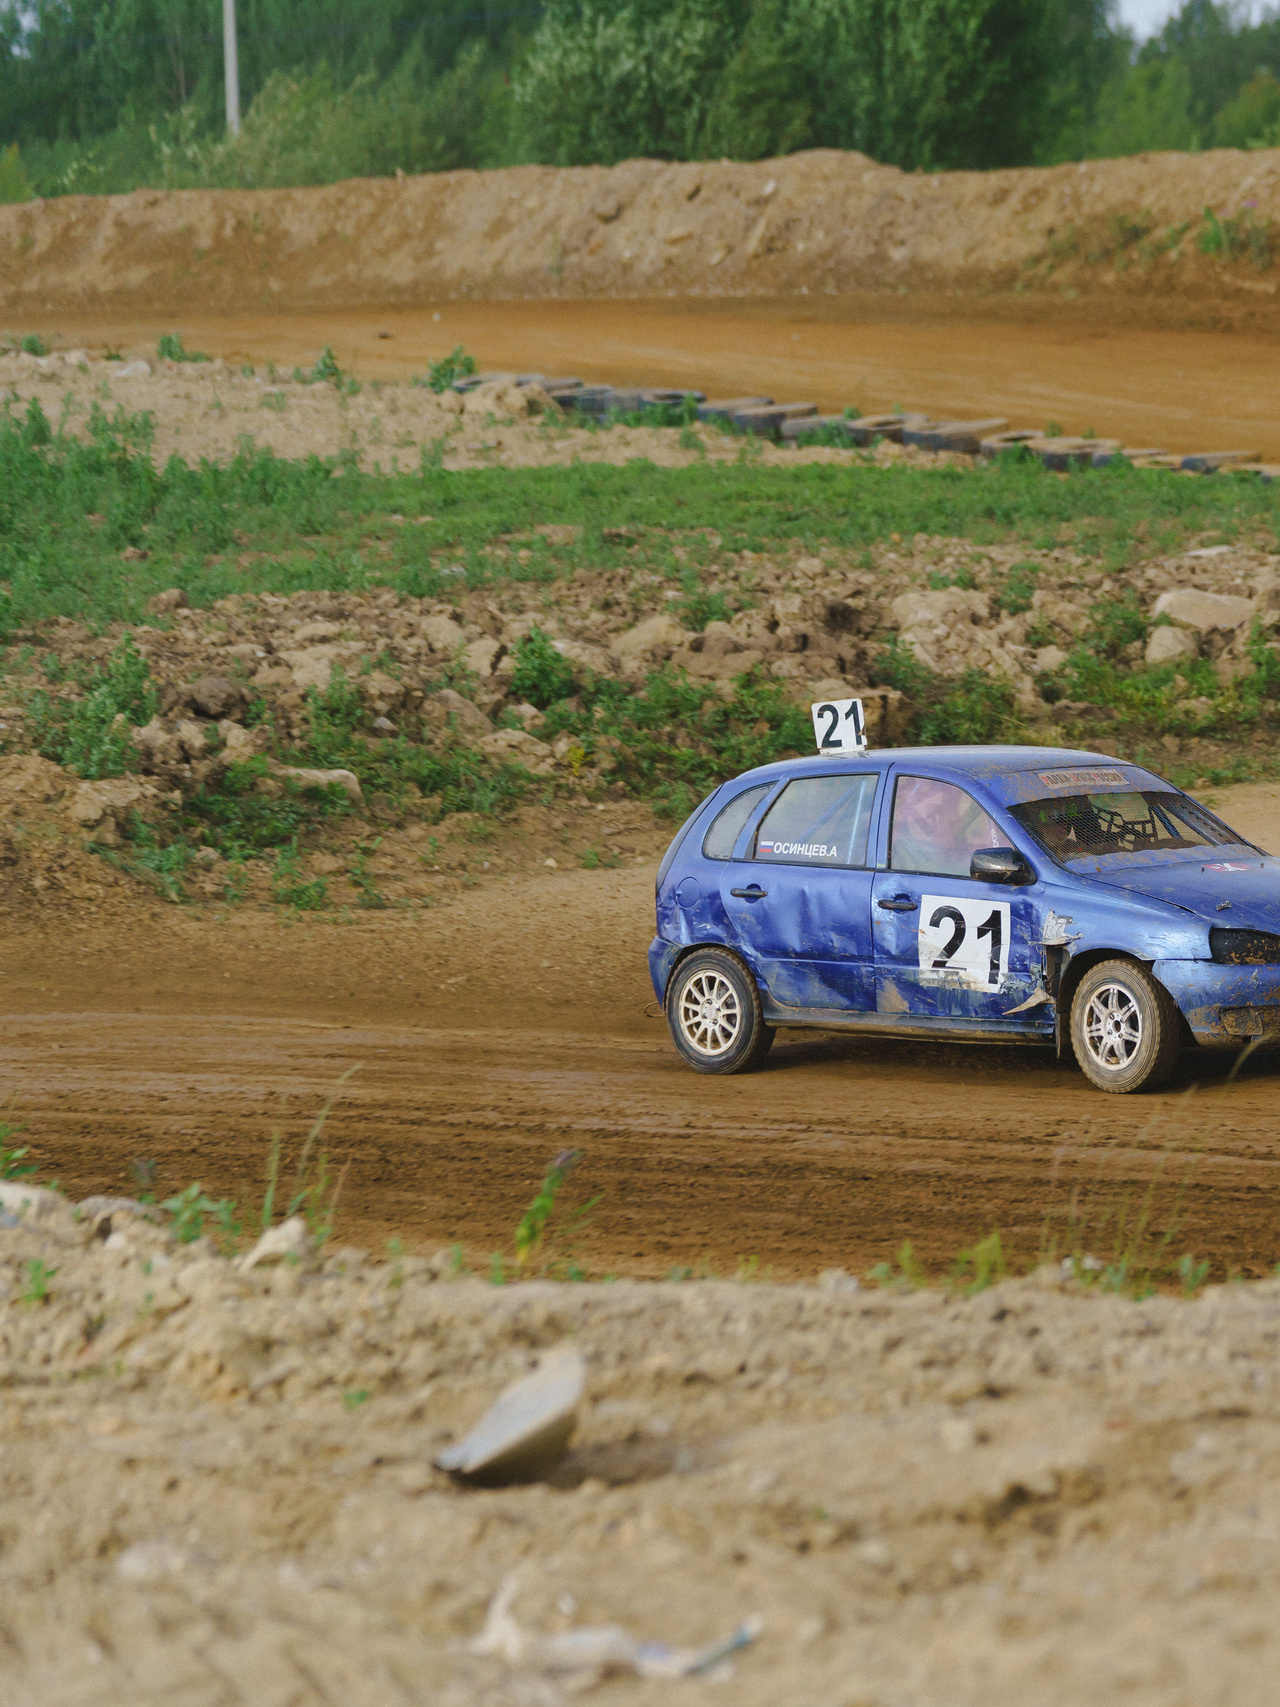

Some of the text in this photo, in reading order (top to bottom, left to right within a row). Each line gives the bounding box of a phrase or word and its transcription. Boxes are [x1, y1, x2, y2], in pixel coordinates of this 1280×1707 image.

[817, 701, 862, 747] 21
[774, 842, 837, 857] ОСИНЦЕВ.А
[929, 905, 1001, 984] 21
